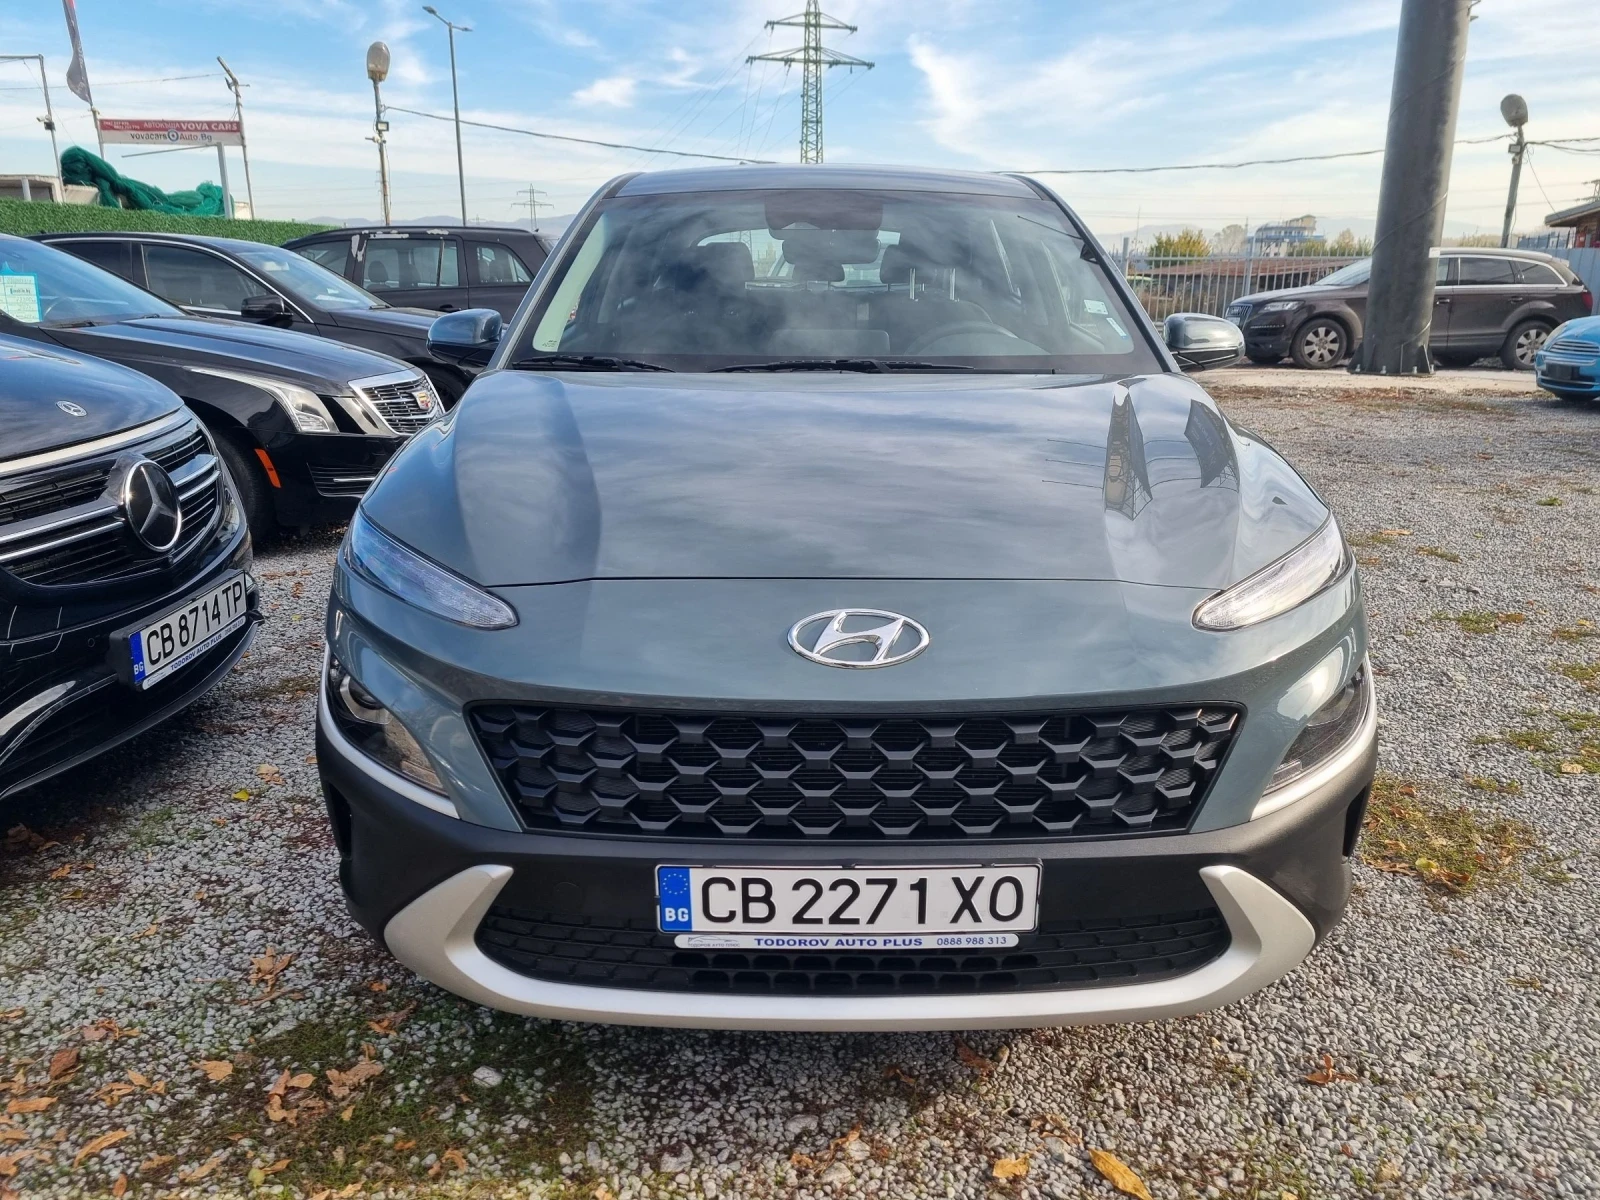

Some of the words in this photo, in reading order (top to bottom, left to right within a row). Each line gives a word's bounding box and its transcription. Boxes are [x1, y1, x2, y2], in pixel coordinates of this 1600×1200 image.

[212, 123, 237, 131] CARS
[147, 622, 175, 666] CB
[178, 594, 221, 647] 8714
[222, 580, 243, 618] TP
[171, 651, 195, 671] TODOROV
[196, 642, 210, 655] AUTO
[210, 634, 222, 647] PLUS
[134, 662, 144, 675] BG
[701, 876, 776, 924] CB
[792, 877, 928, 925] 2271
[950, 875, 1024, 923] XO
[665, 908, 689, 921] BG
[754, 938, 830, 947] TODOROV
[835, 938, 877, 947] AUTO
[882, 938, 923, 947] PLUS
[937, 937, 962, 946] 0888
[965, 937, 985, 946] 988
[988, 936, 1007, 945] 313
